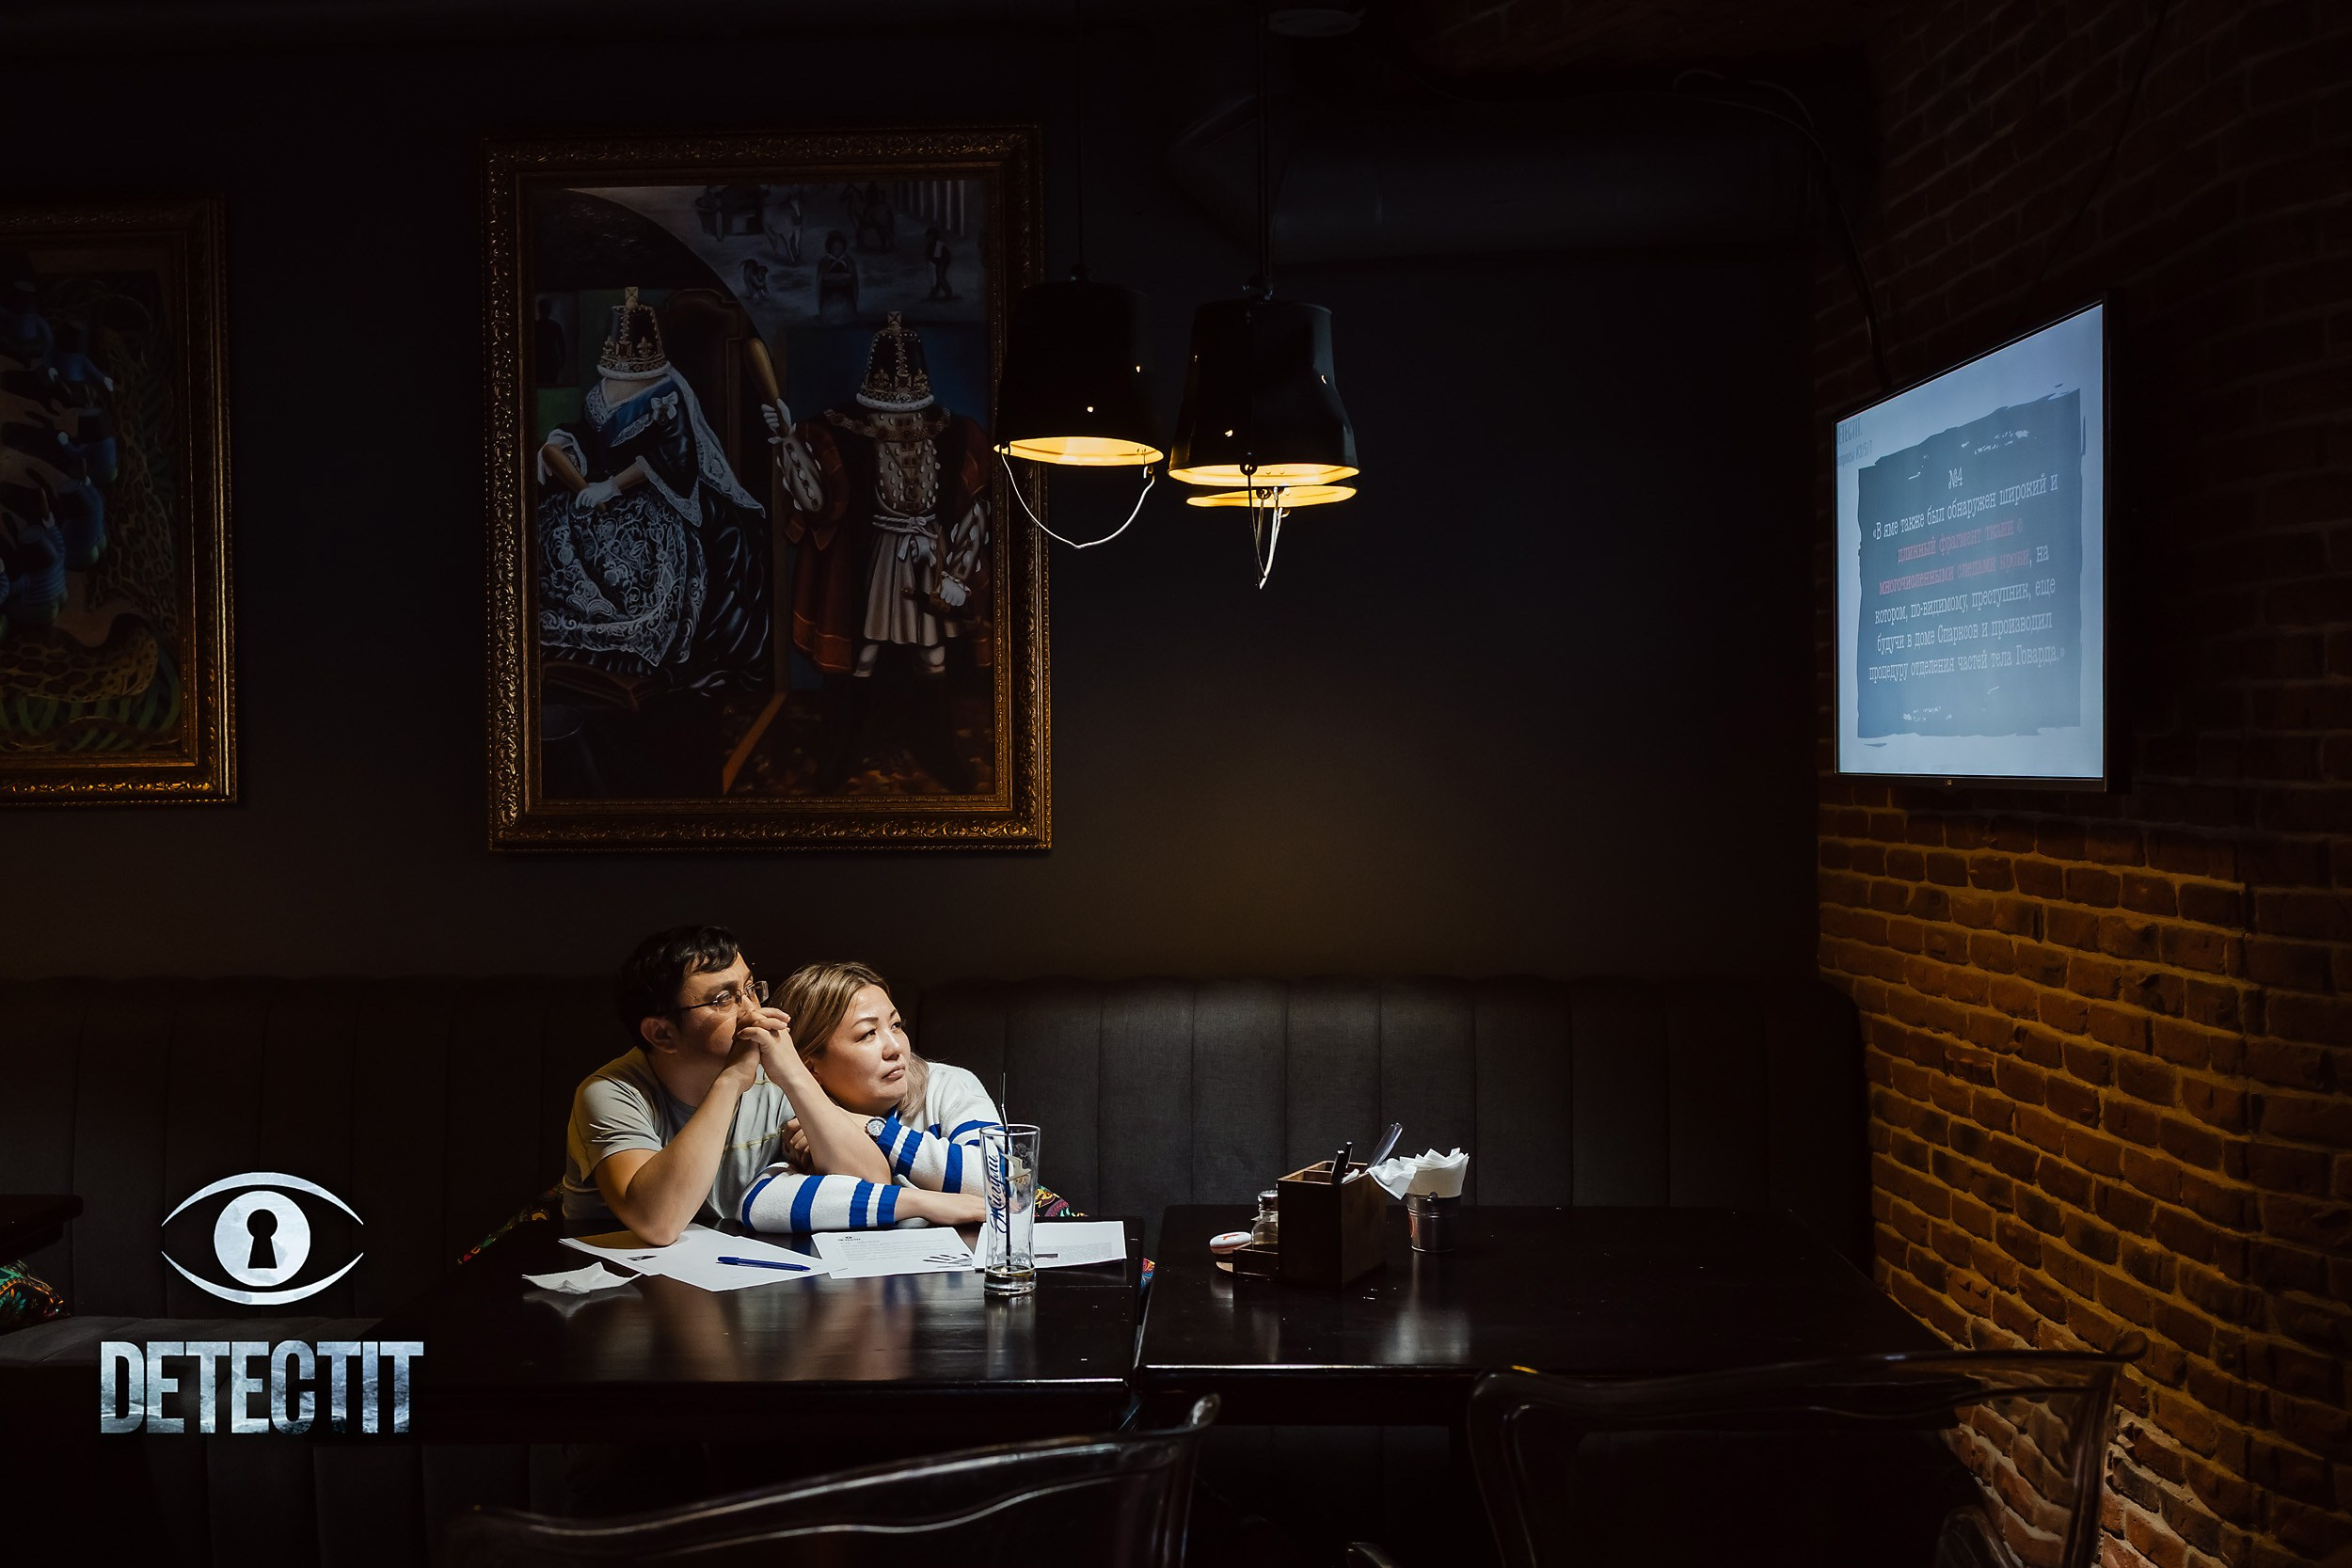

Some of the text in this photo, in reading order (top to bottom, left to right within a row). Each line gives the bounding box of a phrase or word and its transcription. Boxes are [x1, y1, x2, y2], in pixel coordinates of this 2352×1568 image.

[1948, 467, 1963, 489] №4
[1883, 521, 1899, 538] яме
[1900, 514, 1925, 533] также
[1927, 505, 1945, 526] был
[1947, 492, 1996, 521] обнаружен
[1999, 473, 2047, 506] широкий
[2051, 474, 2058, 491] и
[1879, 566, 1955, 595] многочисленными
[1957, 557, 1996, 579] следами
[2036, 546, 2050, 562] на
[1898, 536, 1936, 566] длинный
[1939, 533, 1982, 557] фрагмент
[1875, 578, 2056, 626] котором, по-видимому, преступник, еще
[1877, 612, 2053, 656] будучи в доме Спарксов и производил
[1868, 663, 1909, 684] процедуру
[1911, 657, 1955, 678] отделения
[1958, 649, 1988, 671] частей
[1991, 651, 2012, 668] тела
[987, 1154, 1008, 1234] Жигули
